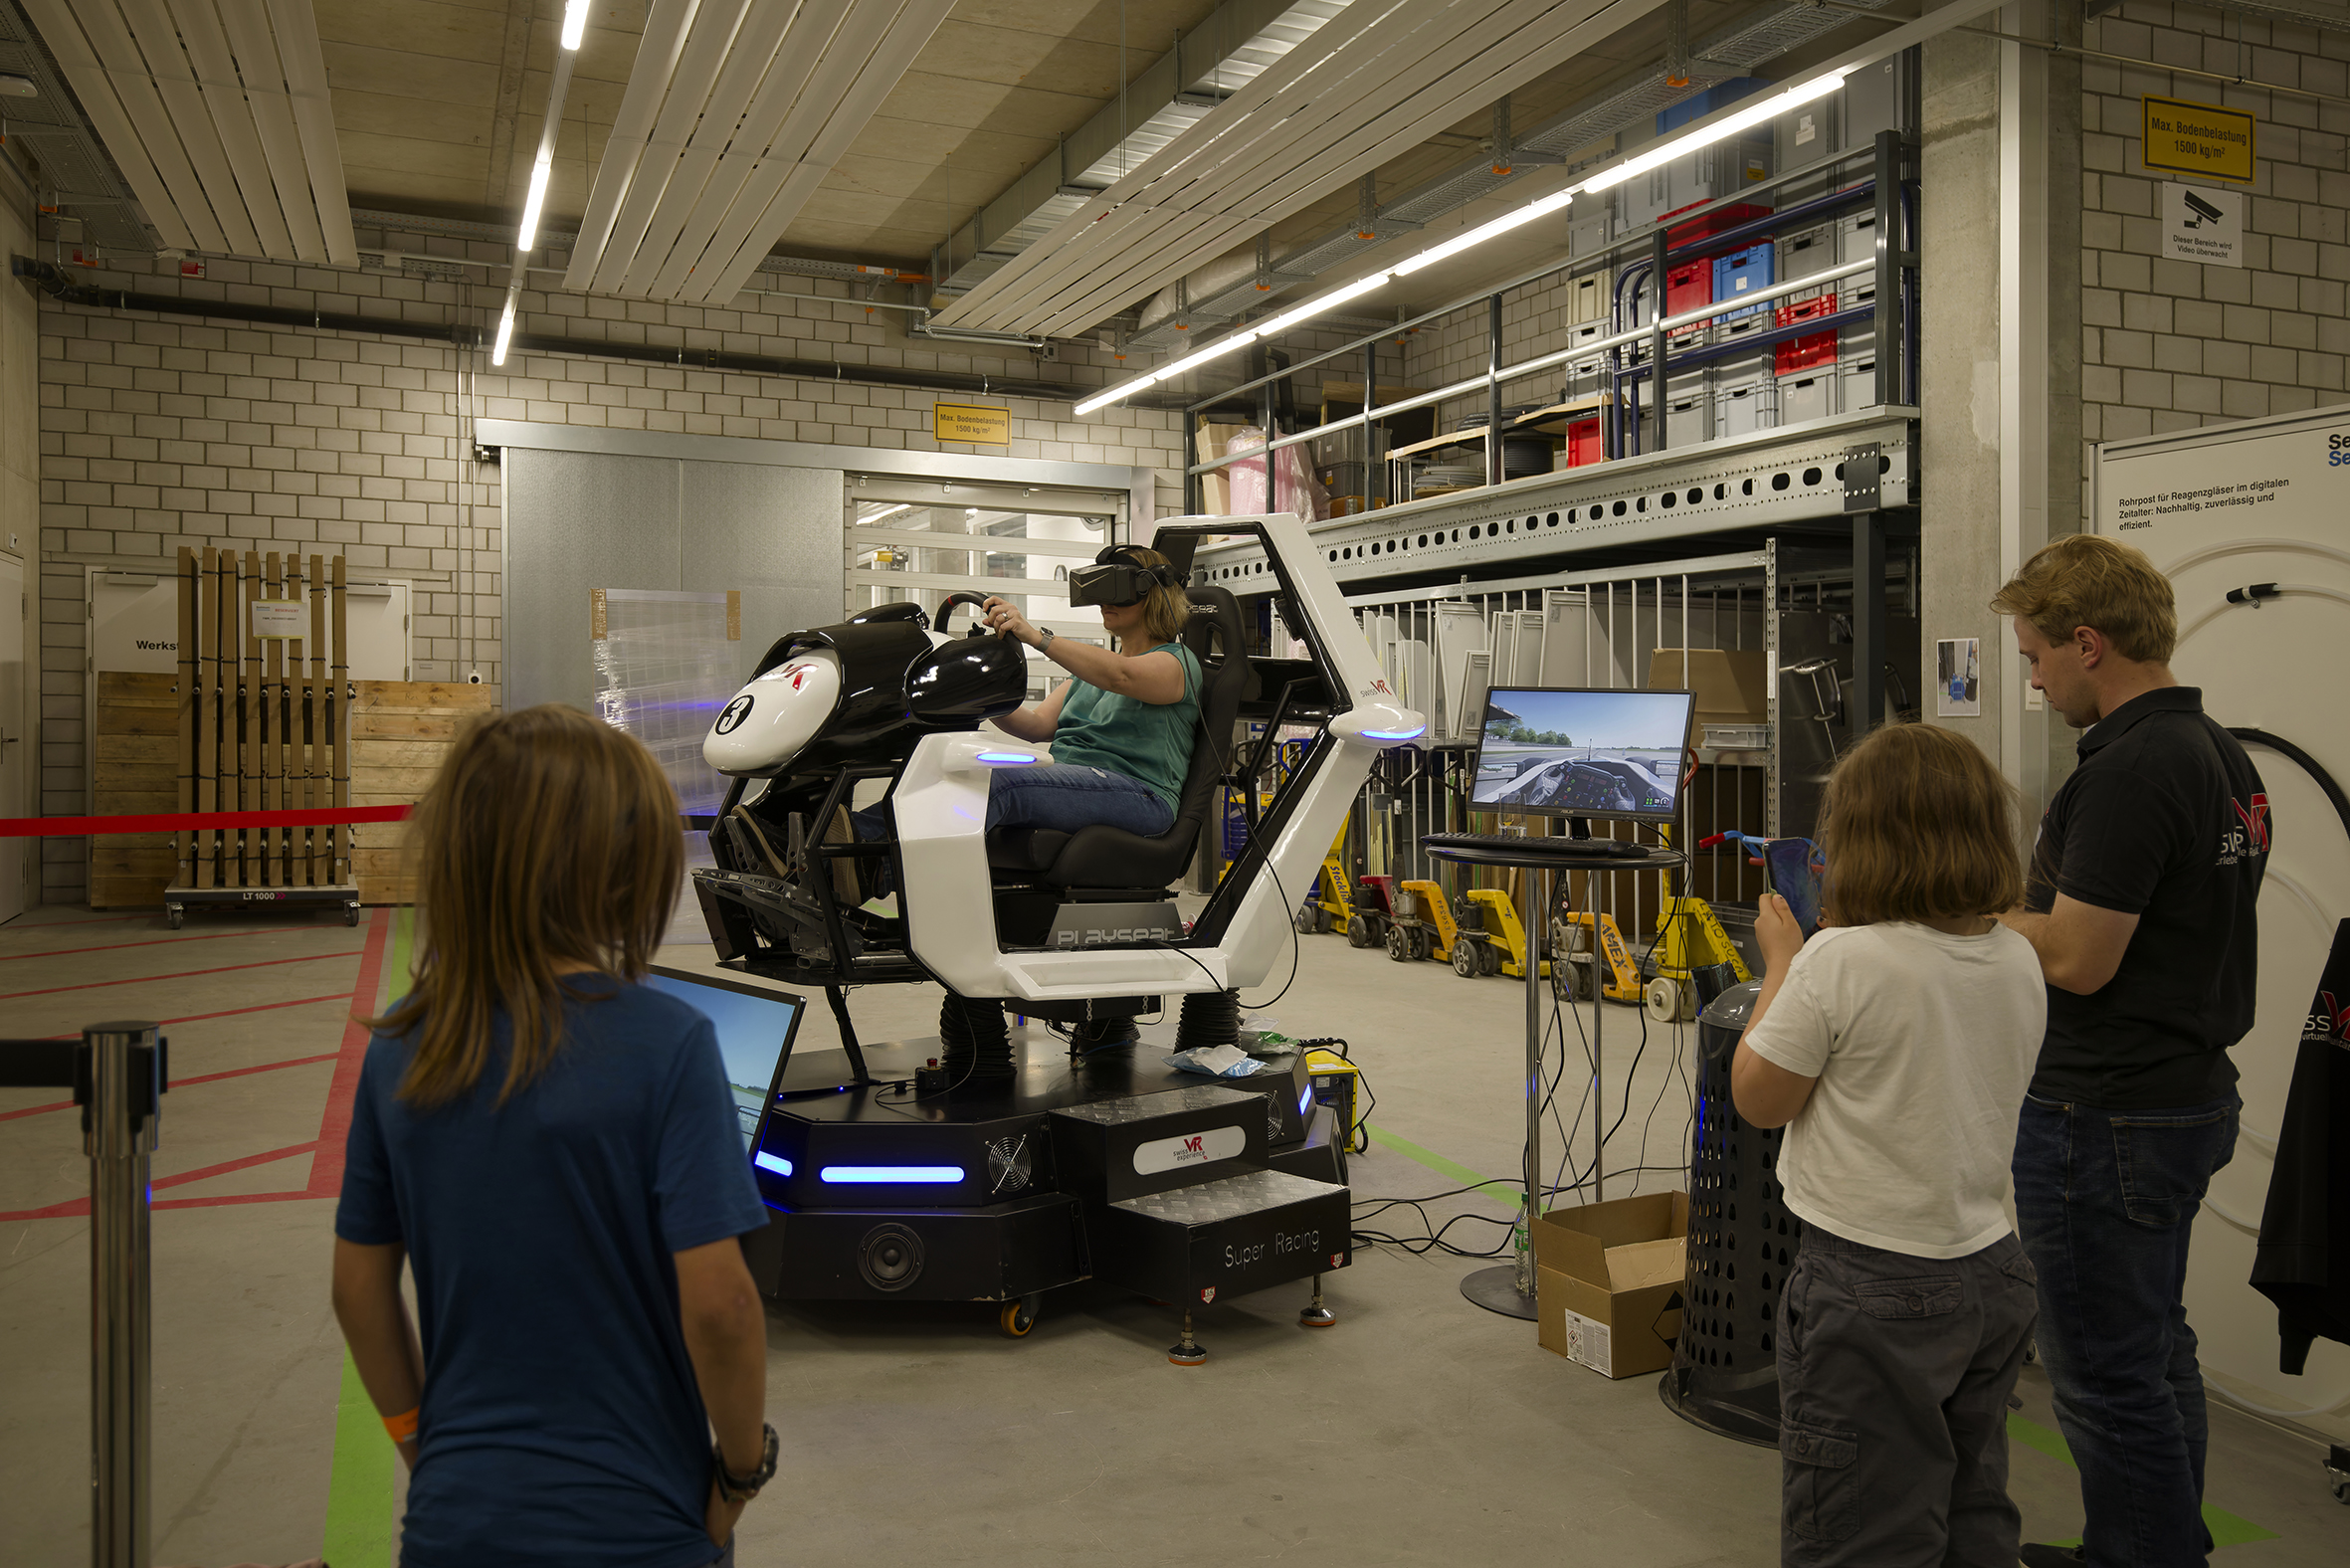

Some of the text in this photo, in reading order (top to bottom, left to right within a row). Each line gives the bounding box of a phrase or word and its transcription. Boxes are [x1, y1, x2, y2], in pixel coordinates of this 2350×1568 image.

[2151, 116, 2248, 146] Max. Bodenbelastung
[2174, 139, 2197, 154] 1500
[2173, 234, 2193, 244] Dieser
[2194, 237, 2218, 247] Bereich
[2177, 244, 2228, 259] Video überwacht
[956, 415, 1006, 427] Bodenbelastung
[2118, 478, 2289, 507] Rohrpost für Reagenzgläser im digitalen
[2118, 492, 2274, 519] Zeitalter: Nachhaltig, zuverlässig und
[2118, 519, 2153, 531] effizient.
[136, 640, 177, 651] Werks
[717, 696, 751, 734] 3
[1173, 1135, 1203, 1157] swiss VR
[1177, 1150, 1206, 1161] experience
[1225, 1230, 1319, 1271] Super Racing
